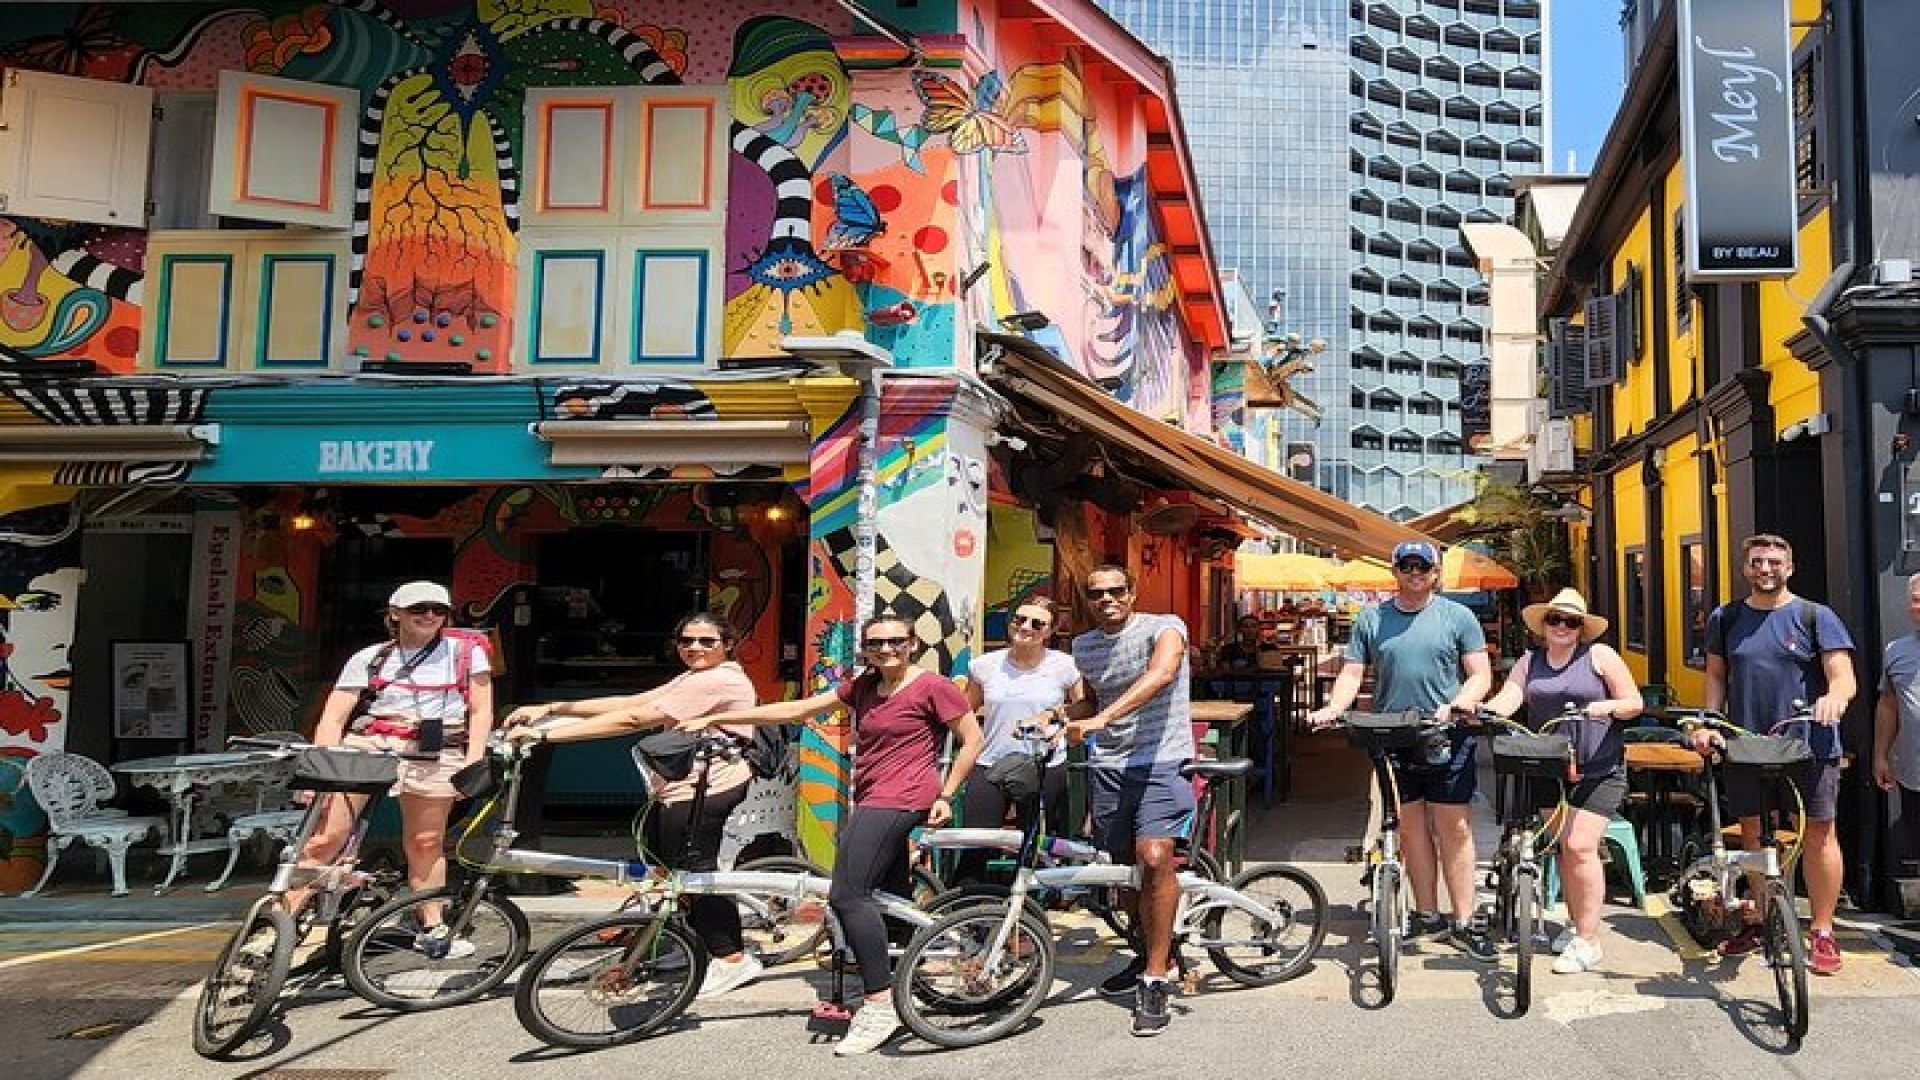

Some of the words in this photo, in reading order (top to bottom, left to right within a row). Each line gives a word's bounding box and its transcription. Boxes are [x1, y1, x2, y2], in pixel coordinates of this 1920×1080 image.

[1695, 35, 1783, 163] Meyl
[1711, 246, 1734, 259] BY
[1735, 246, 1780, 259] BEAU
[319, 440, 434, 471] BAKERY
[208, 525, 230, 617] Eyelash
[197, 624, 223, 740] Extension
